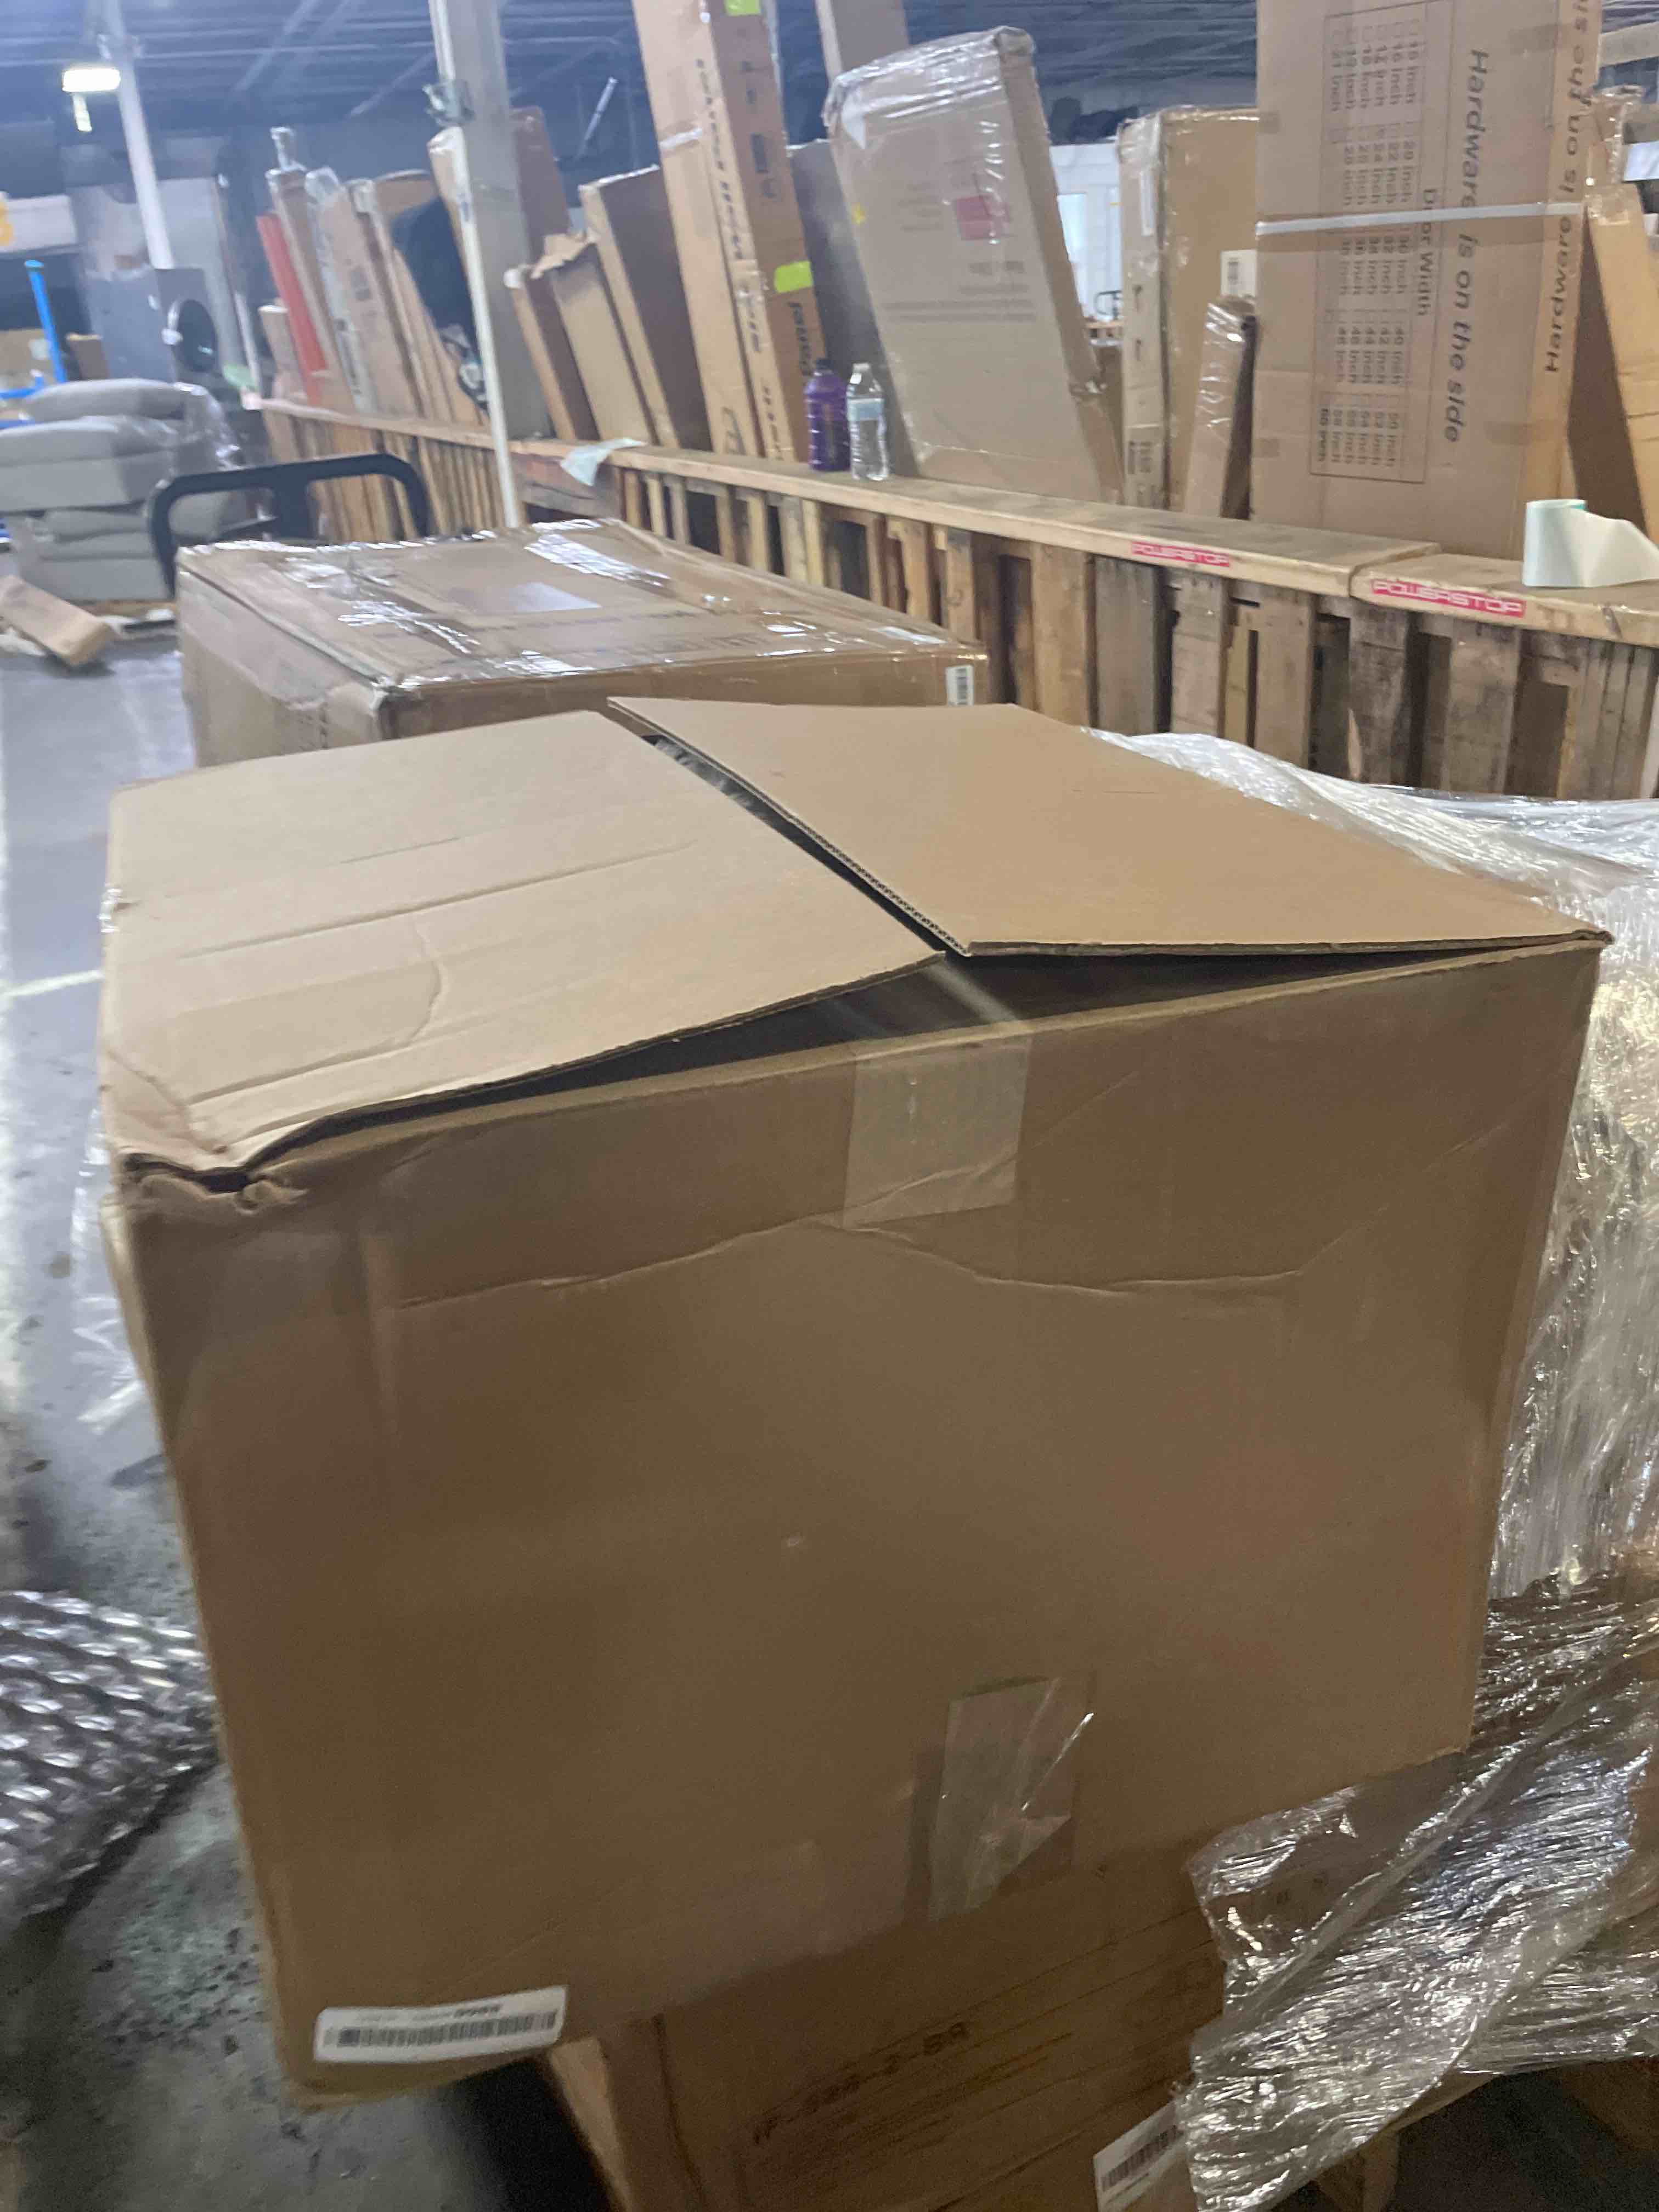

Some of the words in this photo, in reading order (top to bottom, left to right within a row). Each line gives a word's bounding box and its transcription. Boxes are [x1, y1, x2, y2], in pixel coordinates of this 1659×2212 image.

[1568, 45, 1591, 105] the
[1461, 49, 1489, 207] Hardware
[1566, 115, 1580, 155] on
[1421, 188, 1437, 245] Dor
[1458, 234, 1479, 258] is
[1417, 252, 1434, 315] Width
[1455, 270, 1471, 309] on
[1545, 216, 1572, 372] Hardware
[1449, 321, 1471, 370] the
[1444, 379, 1465, 442] side
[1373, 579, 1524, 612] POWERSTOP
